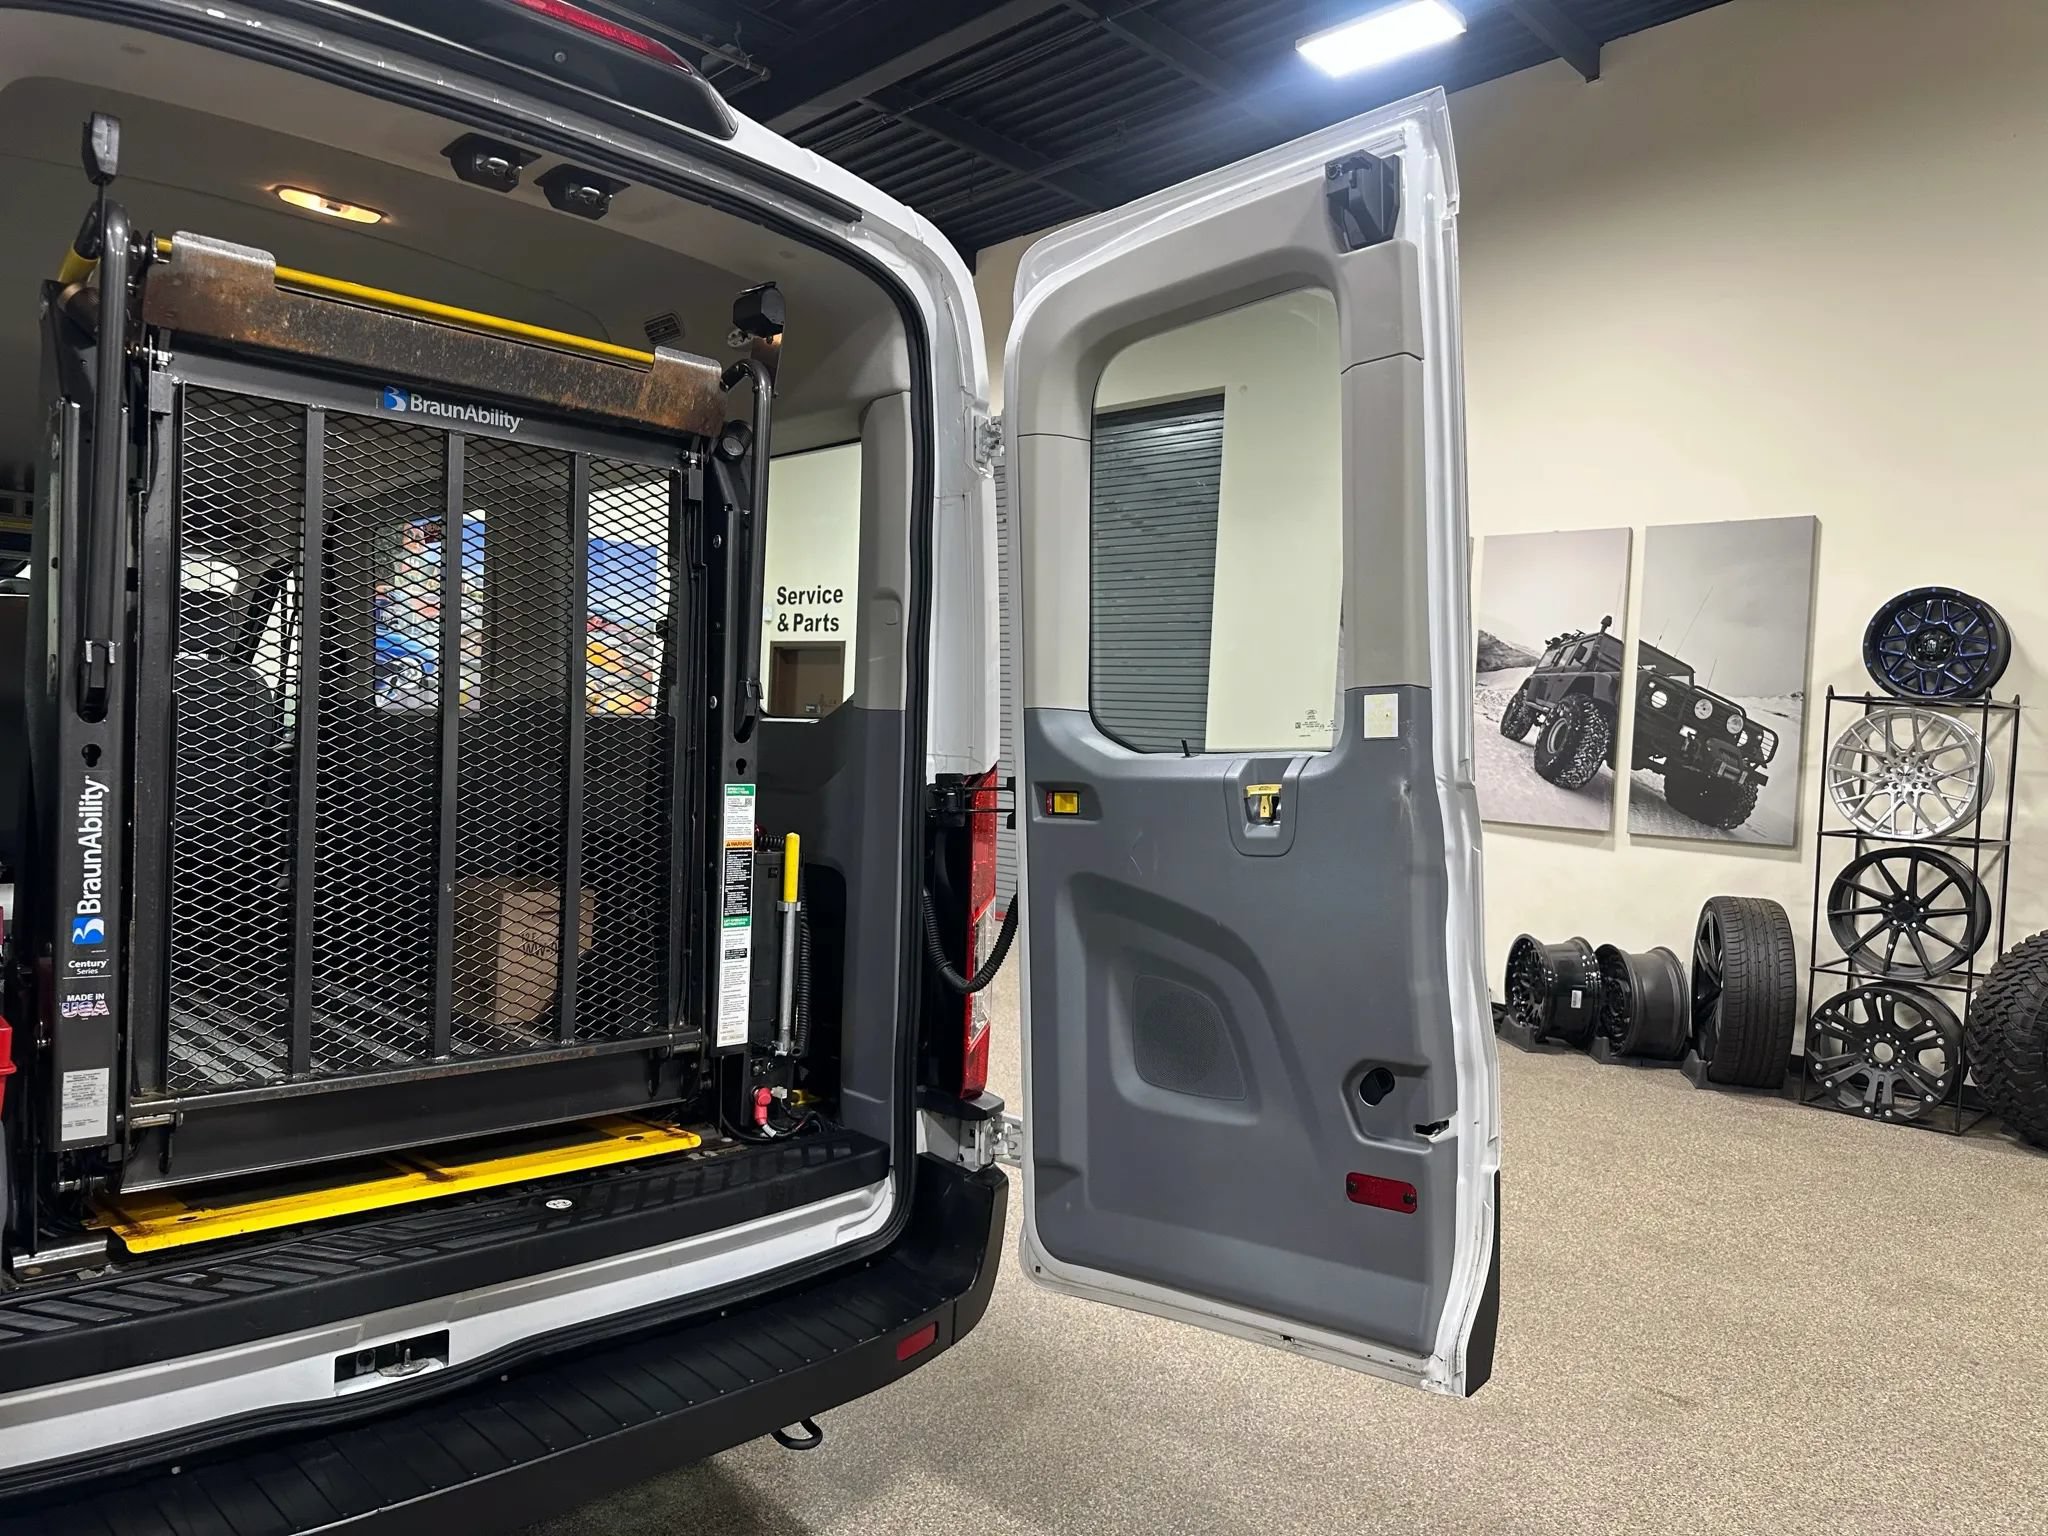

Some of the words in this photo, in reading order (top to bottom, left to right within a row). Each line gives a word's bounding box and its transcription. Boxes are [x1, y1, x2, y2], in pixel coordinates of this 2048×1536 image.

[410, 393, 522, 433] BraunAbility
[776, 585, 843, 605] Service
[777, 613, 789, 632] &
[793, 613, 839, 632] Parts
[76, 776, 110, 914] BraunAbility
[68, 959, 109, 968] Century
[61, 1001, 110, 1018] USA
